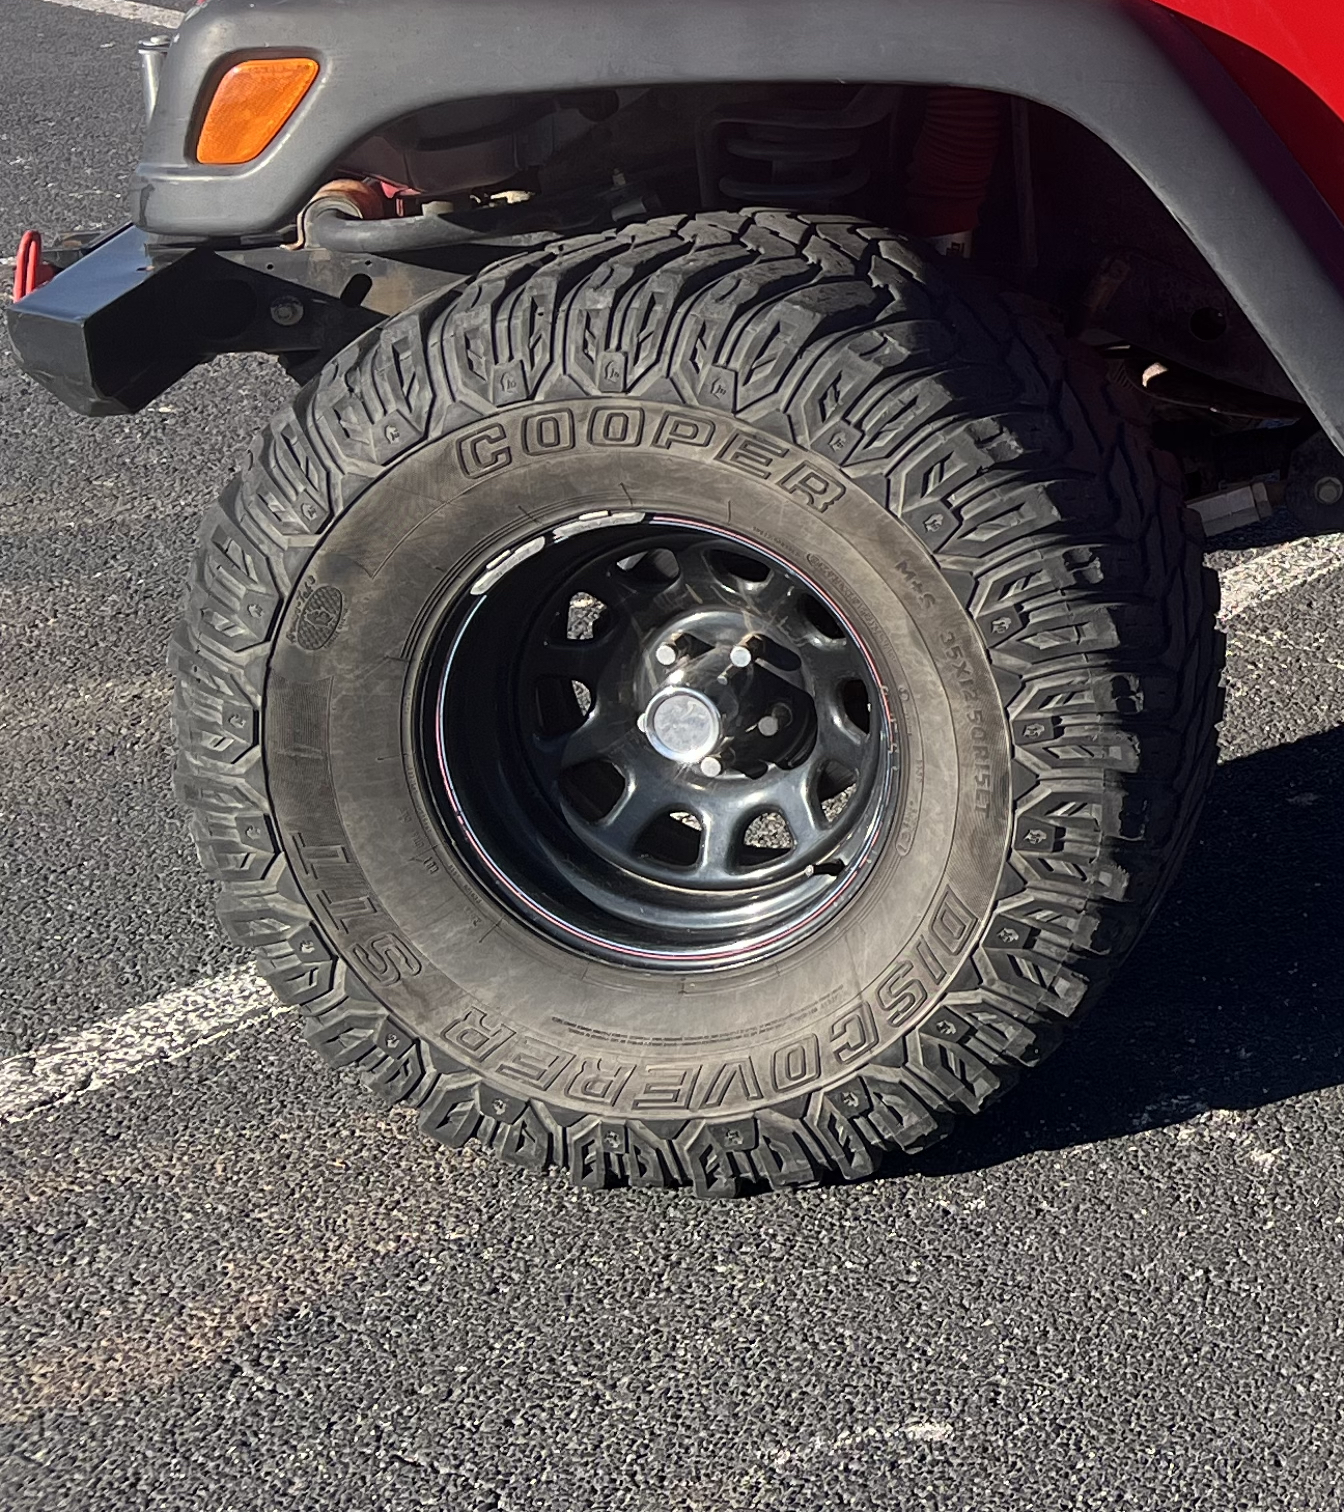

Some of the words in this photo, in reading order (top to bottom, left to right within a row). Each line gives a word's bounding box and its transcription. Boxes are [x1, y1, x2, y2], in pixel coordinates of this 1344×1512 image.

[455, 405, 847, 514] COOPER
[290, 831, 423, 987] STT
[440, 884, 980, 1111] DISCOVERER
